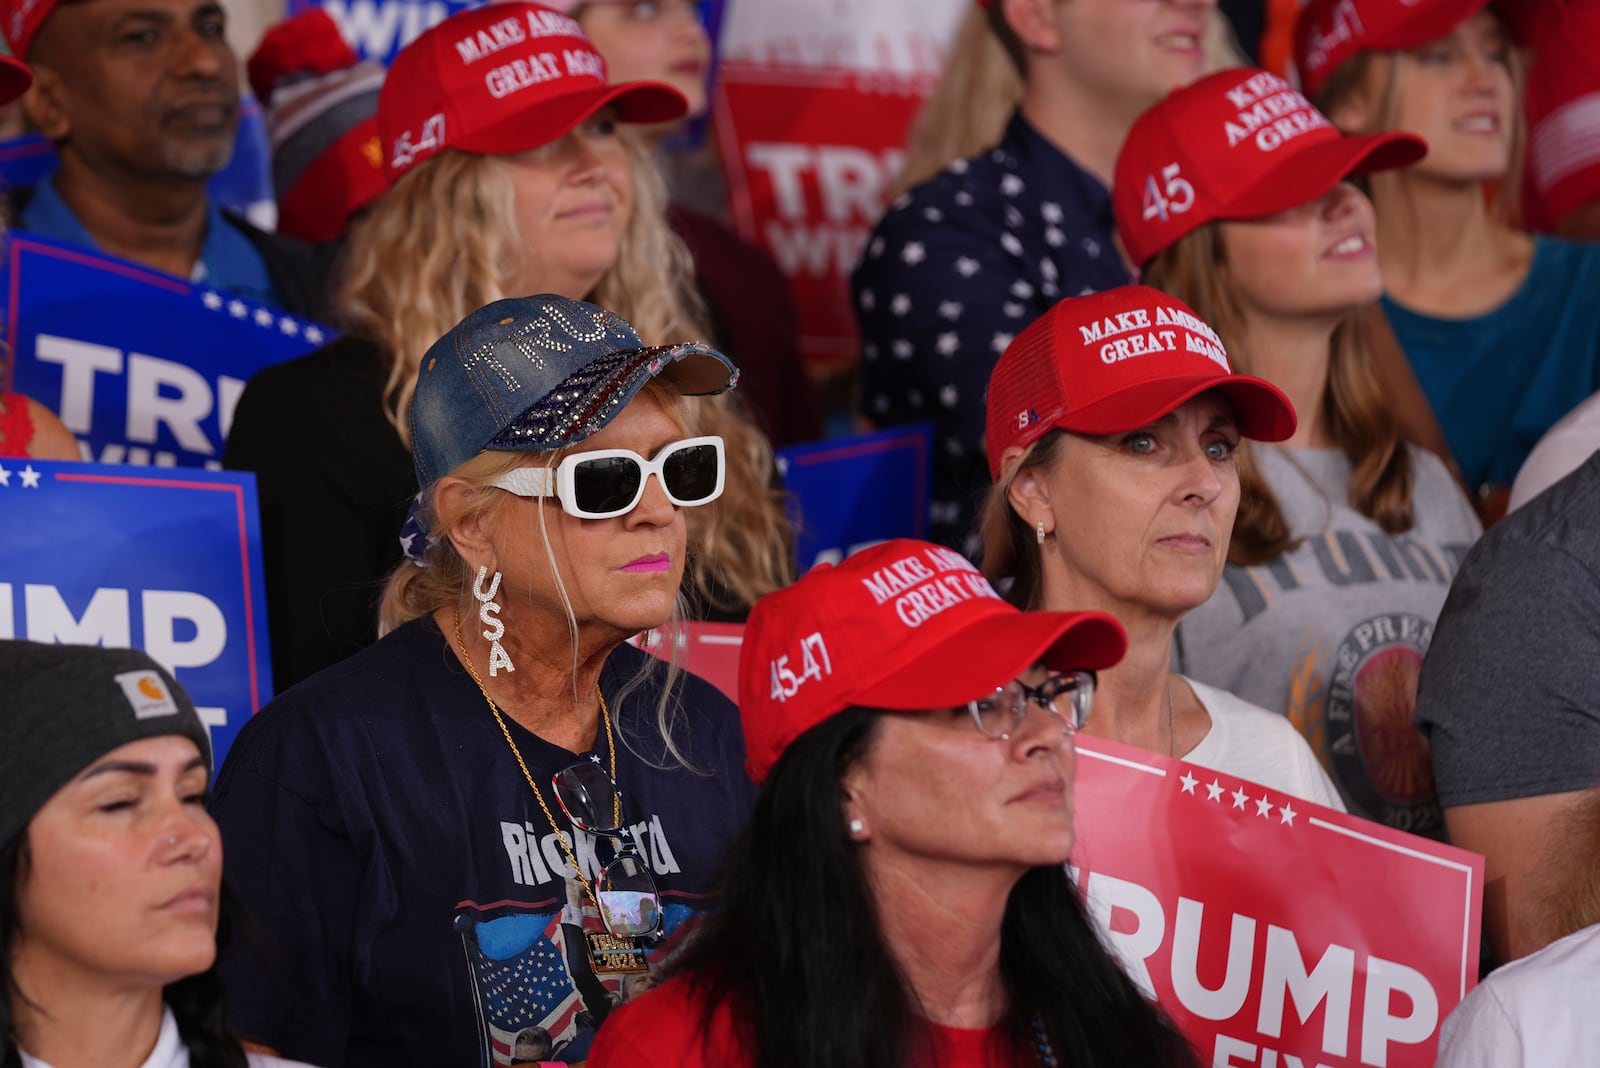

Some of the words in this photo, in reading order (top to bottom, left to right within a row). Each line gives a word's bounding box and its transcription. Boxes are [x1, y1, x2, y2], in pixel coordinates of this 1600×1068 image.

[456, 17, 526, 64] MAKE
[485, 52, 562, 98] GREAT
[745, 140, 907, 222] TR
[1143, 162, 1195, 222] 45
[1079, 309, 1151, 346] MAKE
[1100, 331, 1177, 364] GREAT
[862, 556, 935, 606] MAKE
[896, 575, 972, 628] GREAT
[473, 565, 516, 677] USA
[771, 632, 832, 703] 45-47
[1066, 866, 1440, 1068] RUMP
